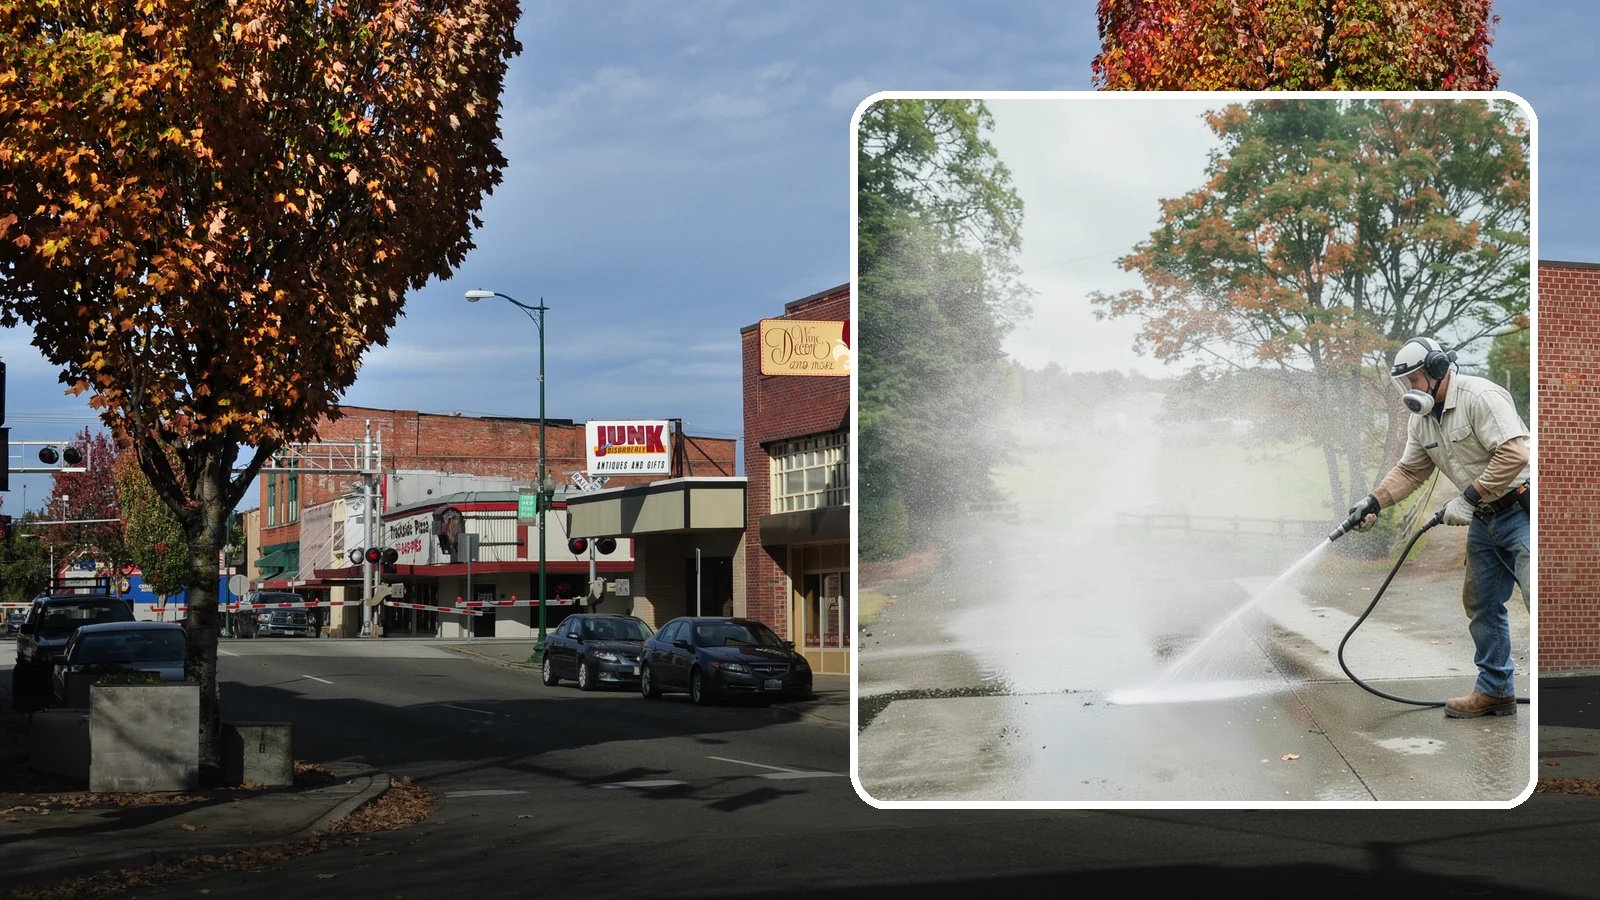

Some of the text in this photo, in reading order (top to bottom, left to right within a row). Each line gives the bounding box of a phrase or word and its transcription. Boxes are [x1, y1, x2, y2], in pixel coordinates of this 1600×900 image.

[595, 425, 665, 457] JUNK
[607, 446, 646, 454] DISORDERLY
[596, 460, 665, 470] ANTIQUES AND GIFTS
[414, 520, 429, 535] Pizza
